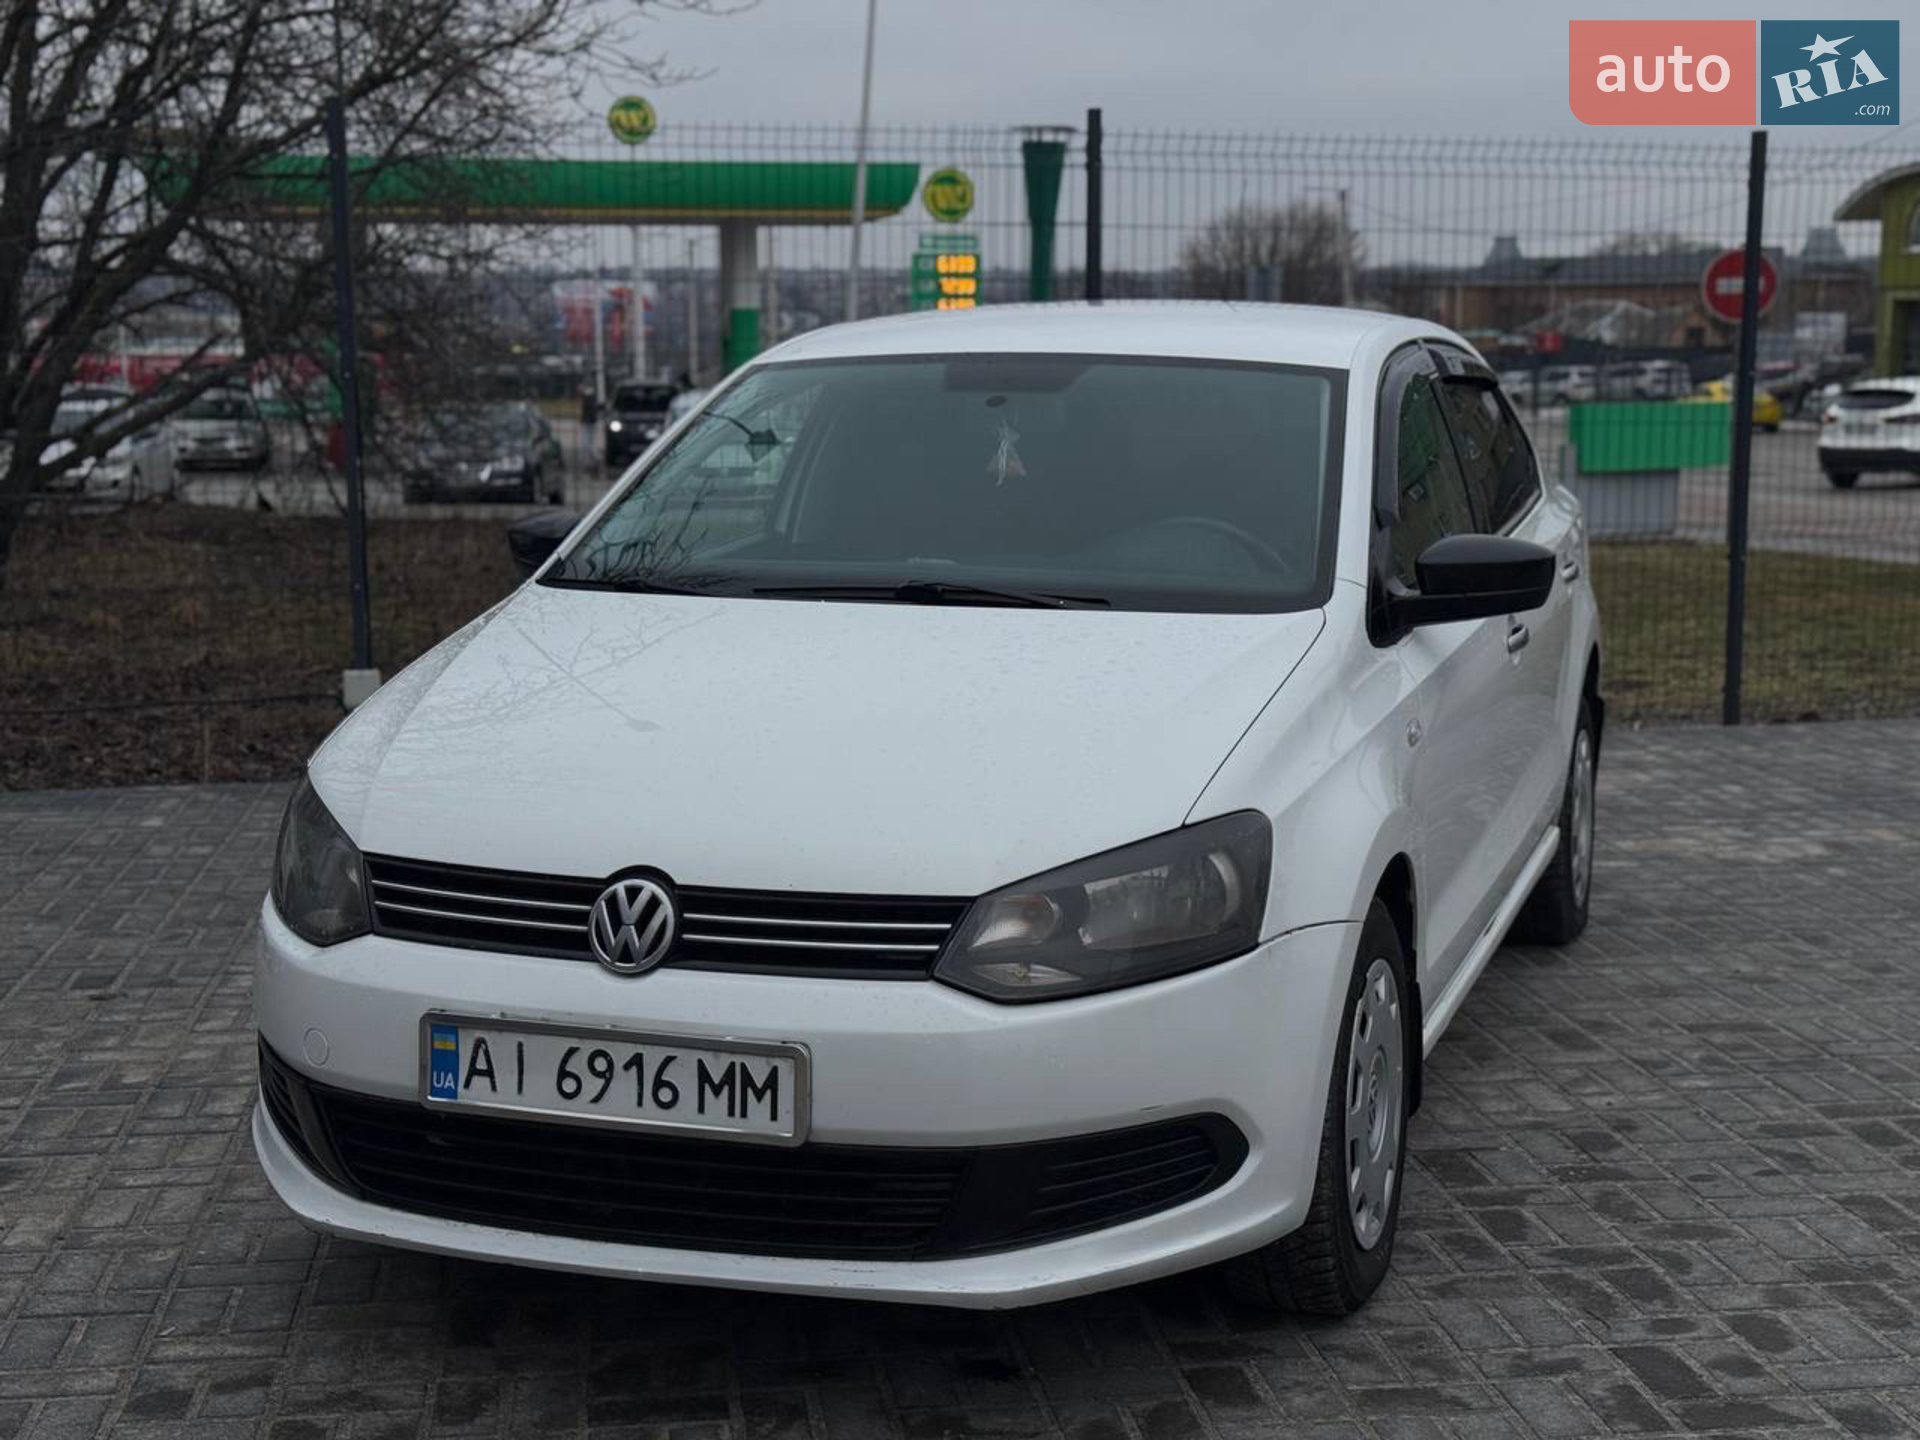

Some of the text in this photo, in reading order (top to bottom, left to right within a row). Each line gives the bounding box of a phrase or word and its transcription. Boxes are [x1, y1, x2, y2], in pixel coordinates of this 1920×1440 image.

[432, 1070, 456, 1091] UA
[463, 1036, 780, 1122] AI 6916 MM
